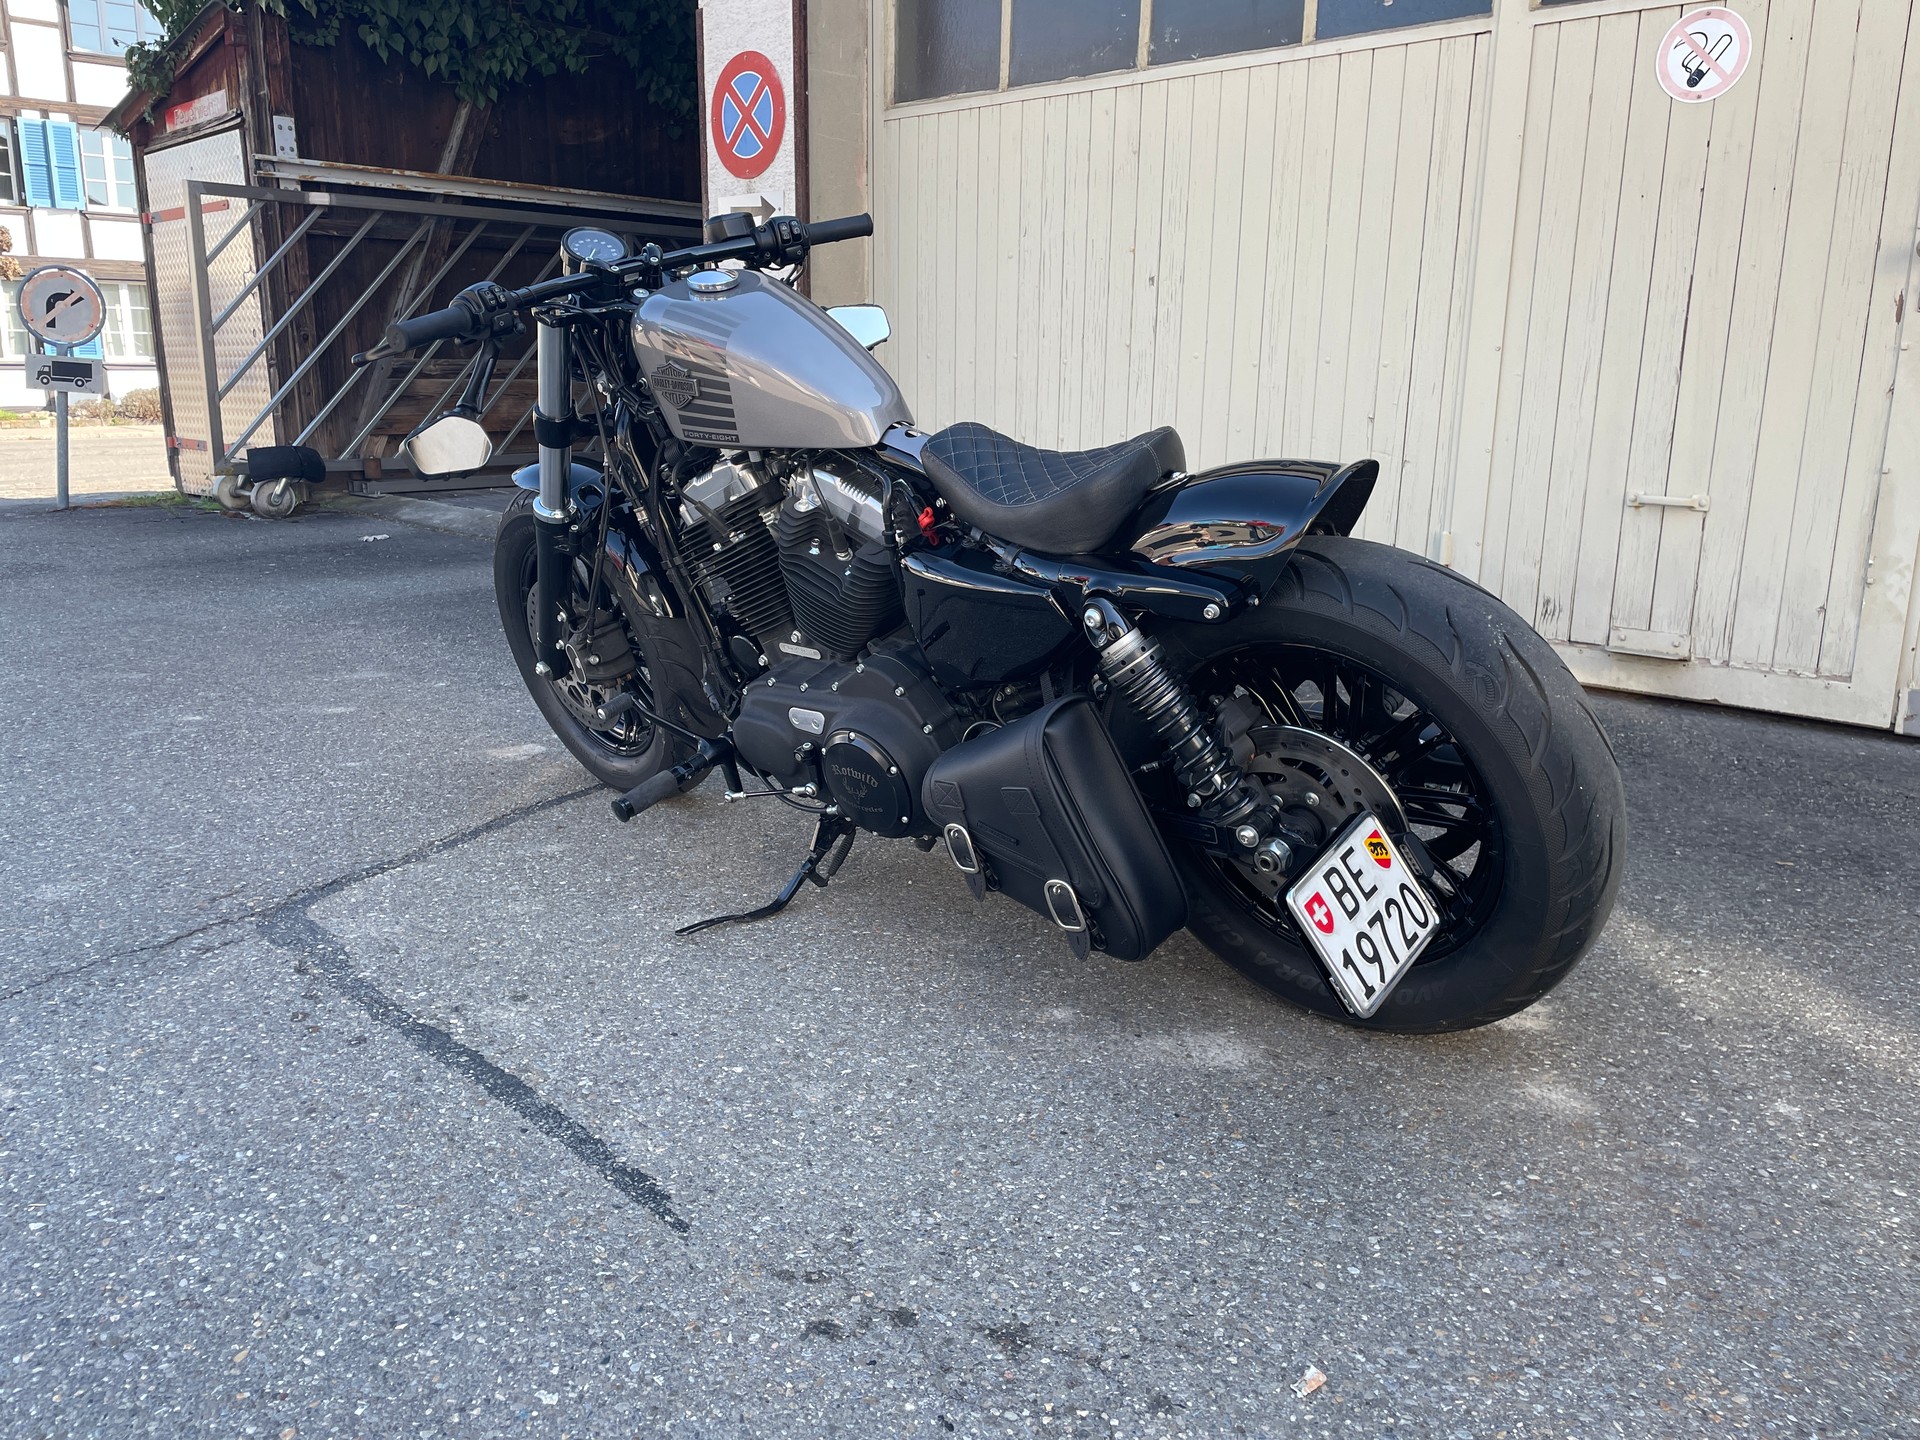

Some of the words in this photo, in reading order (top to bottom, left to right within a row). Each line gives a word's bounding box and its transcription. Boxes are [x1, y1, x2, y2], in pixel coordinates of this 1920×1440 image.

[661, 367, 686, 379] MOTOR
[654, 377, 694, 393] HARLEY-DAVIDSON
[664, 392, 686, 405] CYCLES
[684, 430, 737, 442] FORTY-EIGHT
[831, 763, 880, 788] Rotwild
[1322, 846, 1378, 921] BE
[1342, 882, 1429, 1000] 19720
